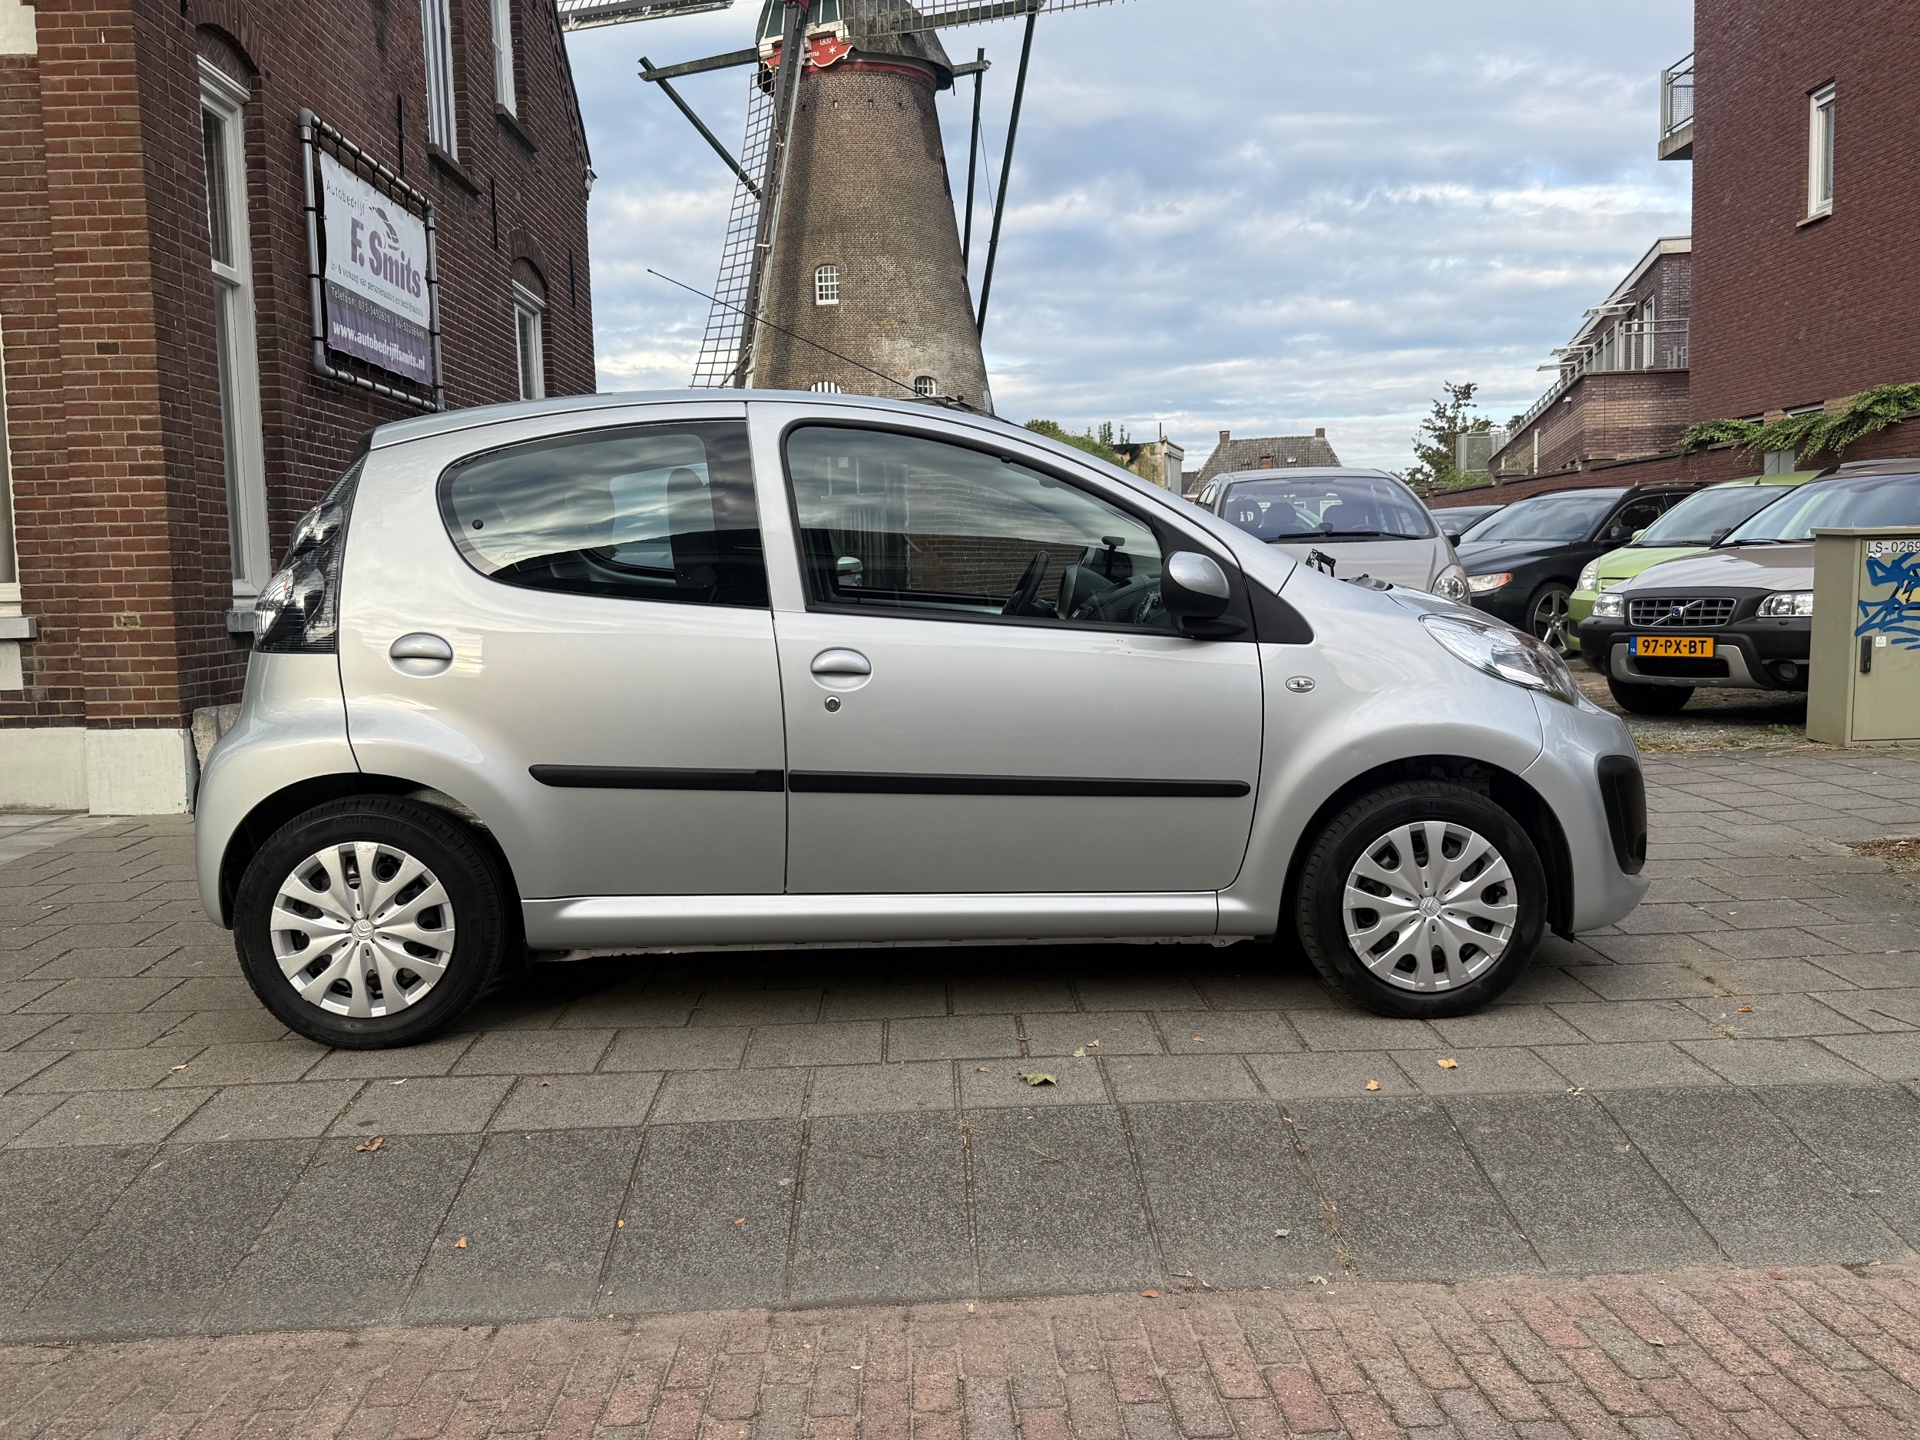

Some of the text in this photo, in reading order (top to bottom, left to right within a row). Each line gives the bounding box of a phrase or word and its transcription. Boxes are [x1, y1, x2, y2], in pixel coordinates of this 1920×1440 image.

[326, 180, 365, 216] Autobedrijf
[350, 216, 421, 298] F. Smits
[332, 321, 426, 371] www.autobedrijffsmits.nl
[1867, 541, 1920, 554] LS-0269
[1642, 639, 1707, 655] 97-PX-BT
